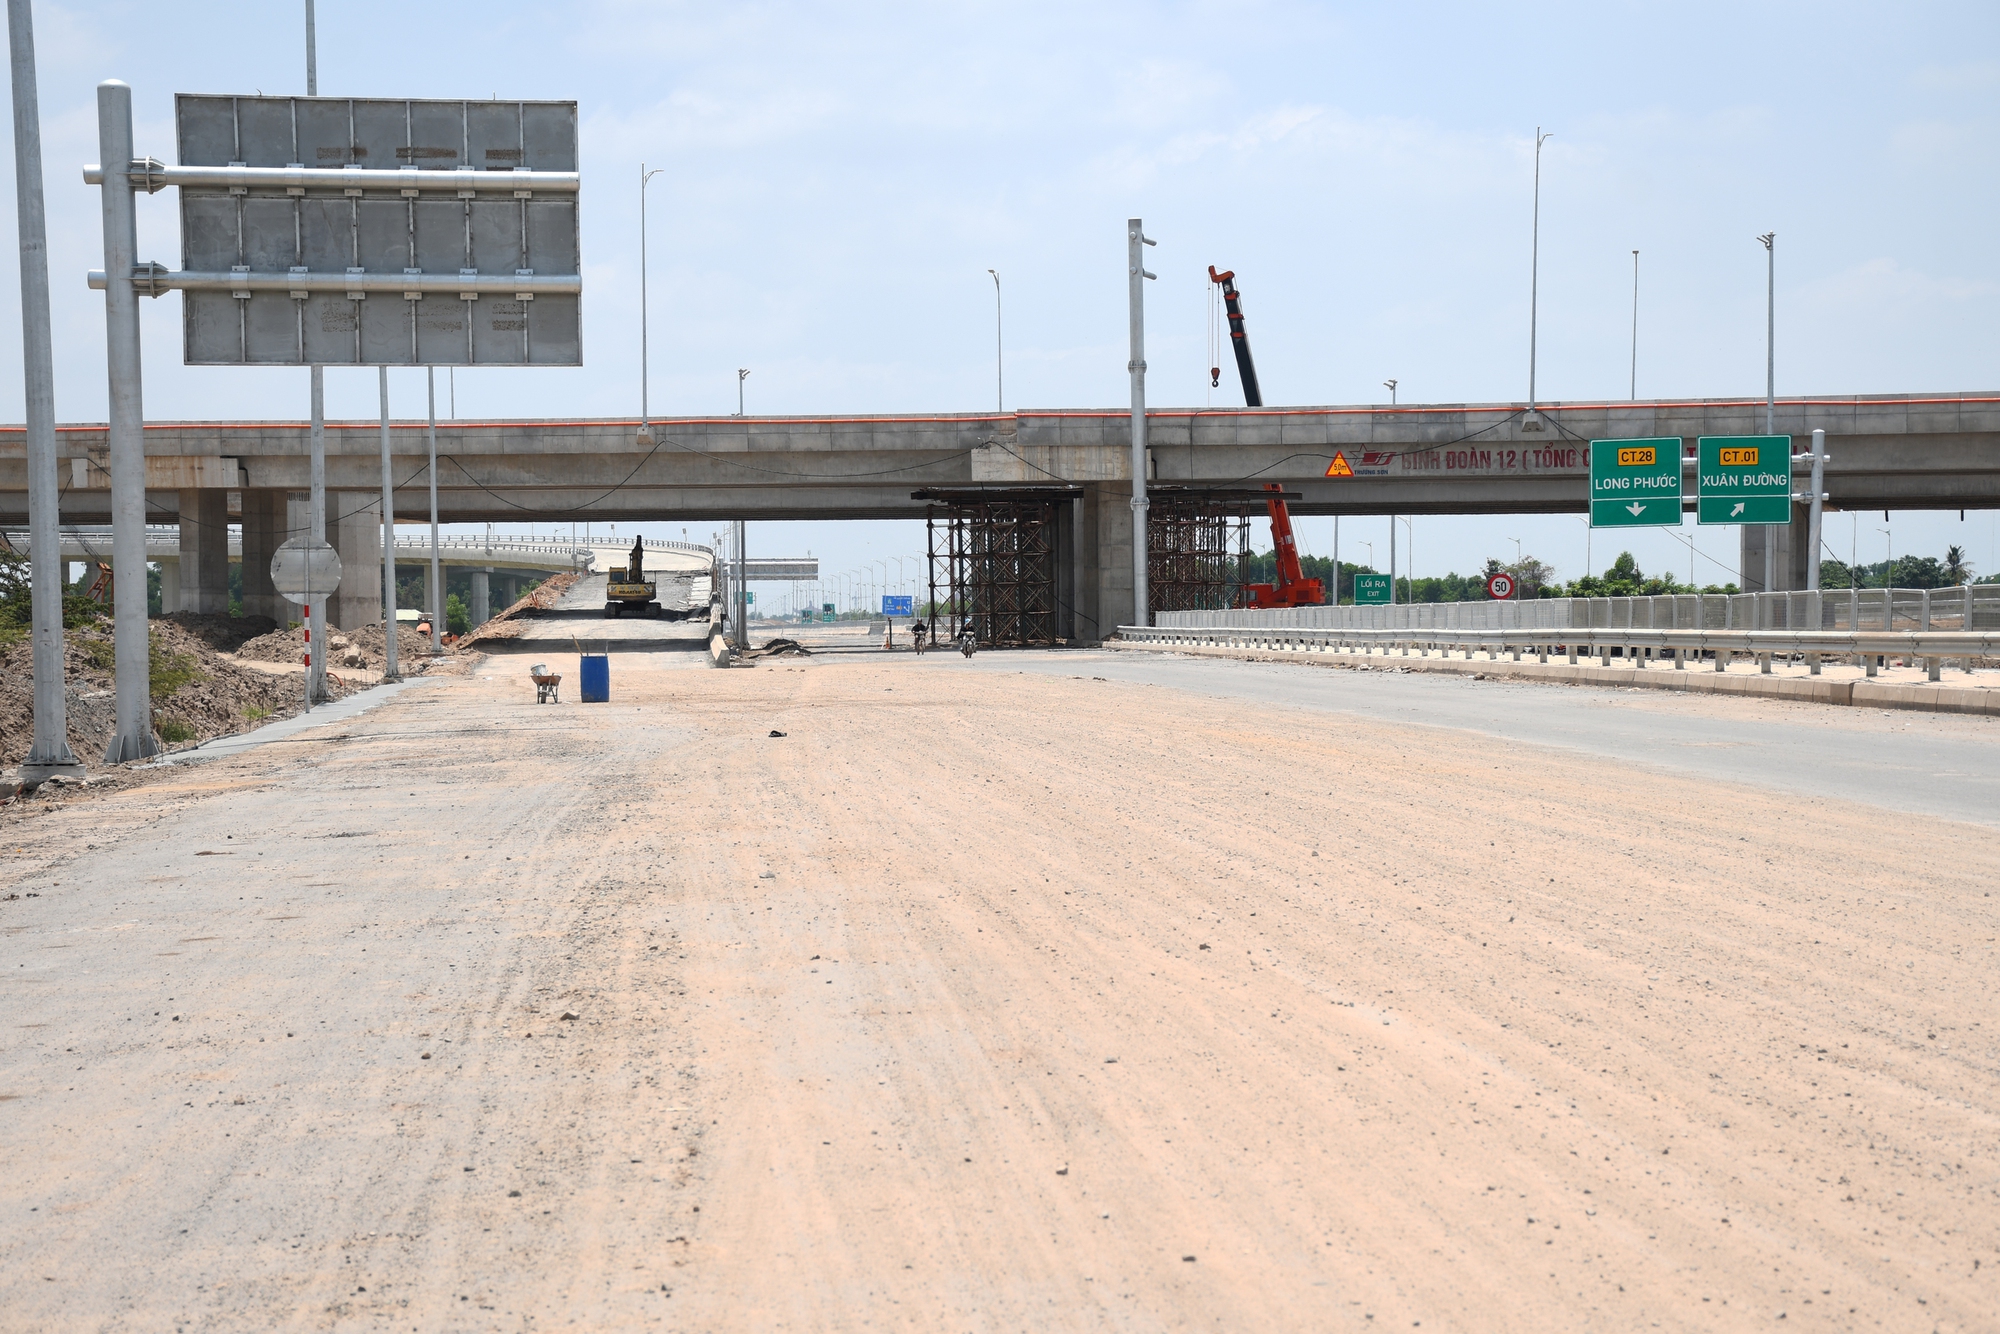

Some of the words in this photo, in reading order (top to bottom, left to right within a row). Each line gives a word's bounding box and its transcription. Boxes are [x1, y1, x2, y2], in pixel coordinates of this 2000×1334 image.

[1446, 447, 1491, 470] ĐOÀN
[1497, 451, 1516, 469] 12
[1533, 442, 1576, 468] TỔNG
[1621, 451, 1653, 462] CT.28
[1723, 451, 1756, 462] CT.01
[1595, 478, 1630, 490] LONG
[1633, 473, 1677, 488] PHƯỚC
[1702, 473, 1739, 487] XUÂN
[1743, 472, 1787, 486] ĐƯỜNG
[1361, 577, 1372, 588] LỐI
[1375, 580, 1386, 588] RA
[1495, 581, 1507, 592] 50
